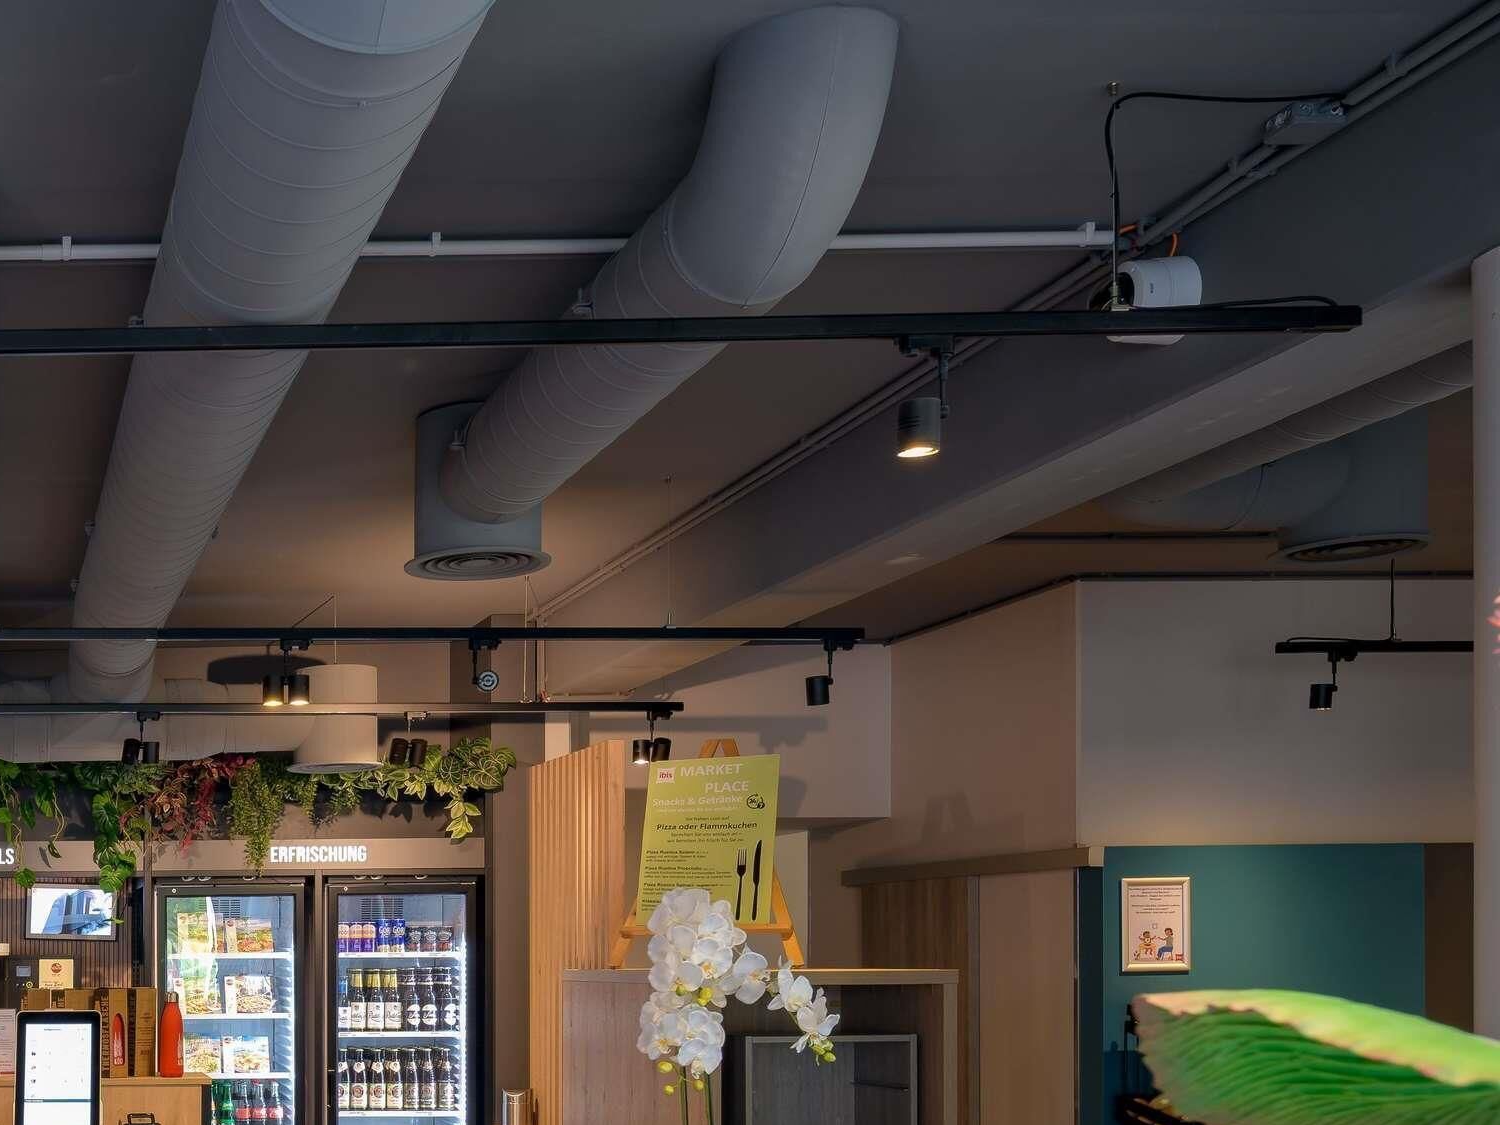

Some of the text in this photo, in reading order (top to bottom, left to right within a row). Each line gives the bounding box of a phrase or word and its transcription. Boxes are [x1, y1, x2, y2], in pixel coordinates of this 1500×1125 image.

[658, 770, 673, 780] ibis
[680, 764, 743, 778] MARKET
[705, 780, 749, 794] PLACE
[656, 820, 757, 831] Pizza oder Flammkuchen
[270, 845, 367, 863] ERFRISCHUNG
